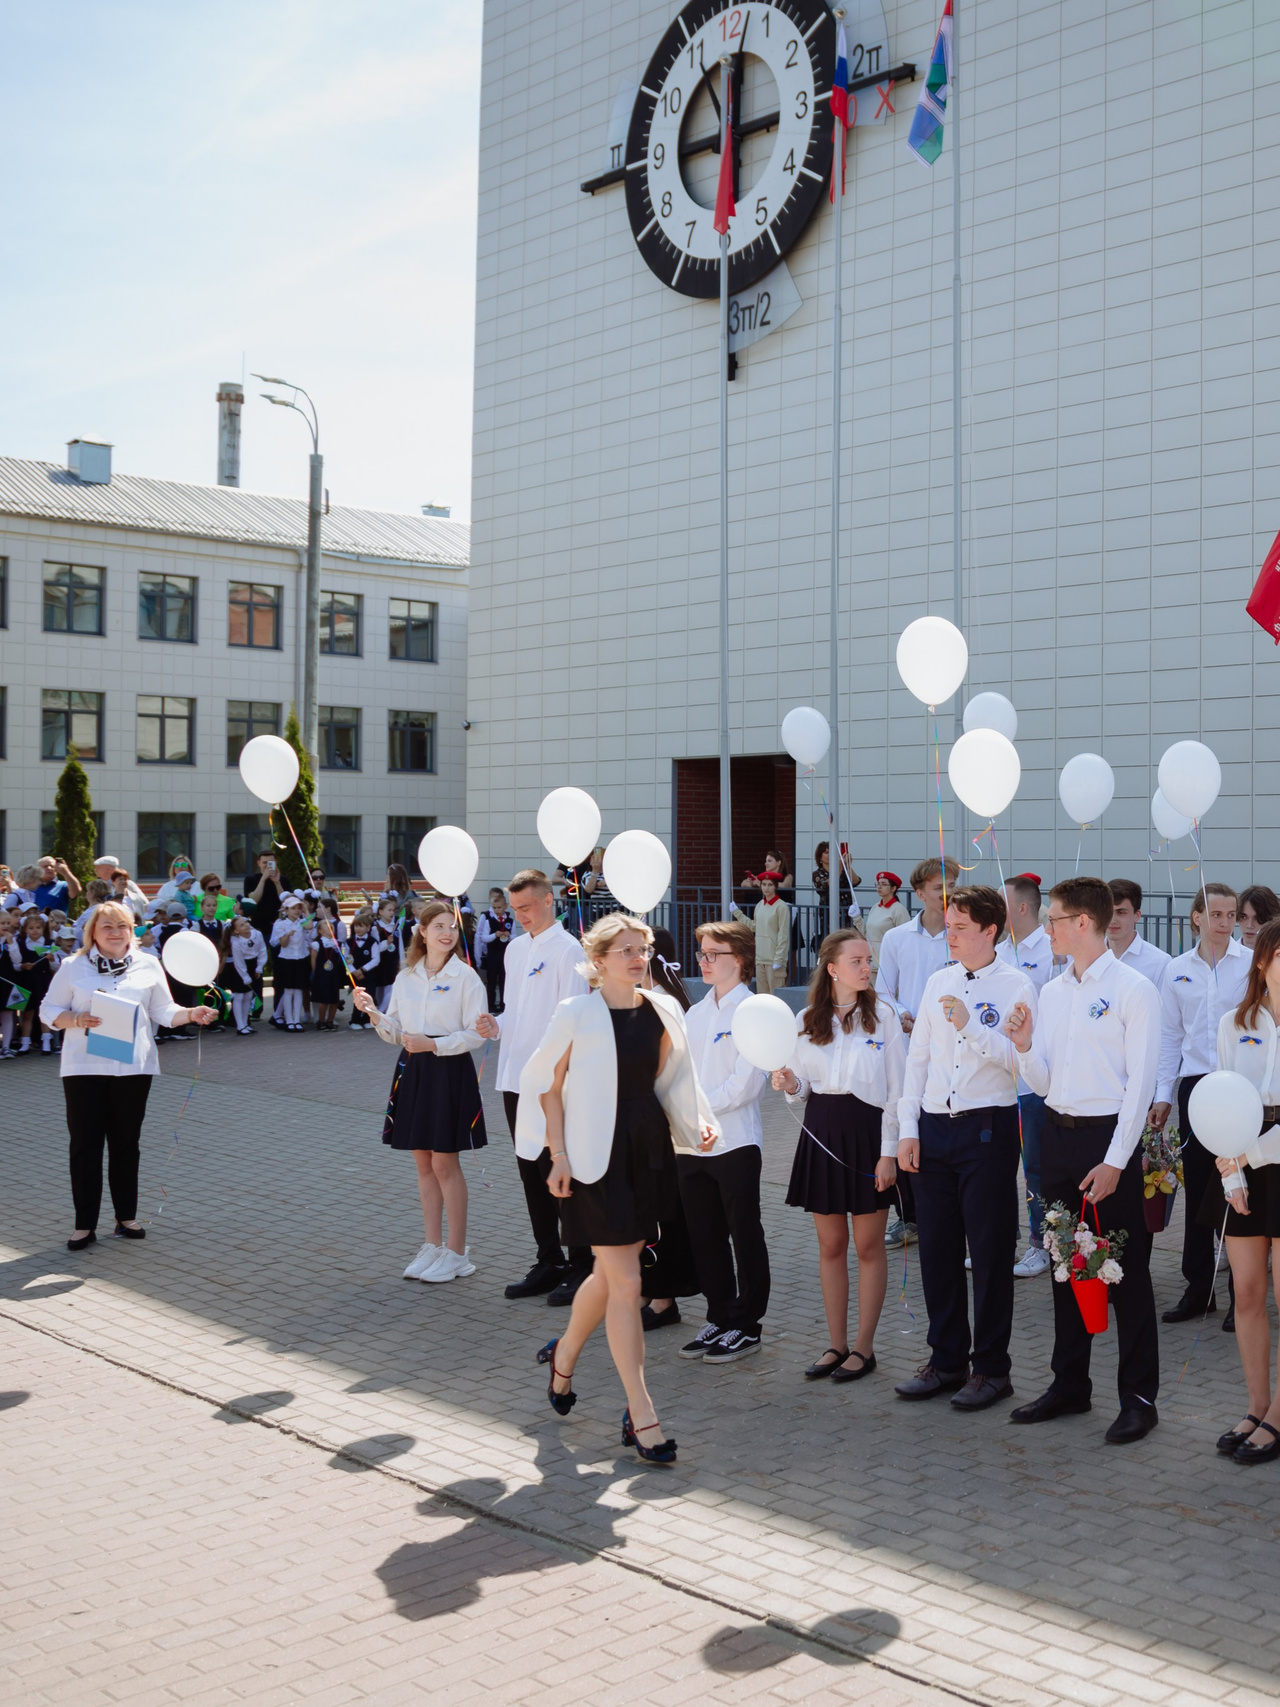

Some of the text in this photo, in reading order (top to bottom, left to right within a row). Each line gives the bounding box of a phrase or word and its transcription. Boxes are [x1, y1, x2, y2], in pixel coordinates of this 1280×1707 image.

[719, 10, 742, 42] 12
[761, 10, 770, 38] 1
[686, 38, 704, 69] 11
[785, 39, 799, 69] 2
[660, 86, 682, 118] 10
[795, 90, 808, 119] 3
[653, 142, 666, 170] 9
[782, 147, 797, 176] 4
[660, 190, 673, 218] 8
[754, 196, 768, 226] 5
[684, 219, 698, 249] 7
